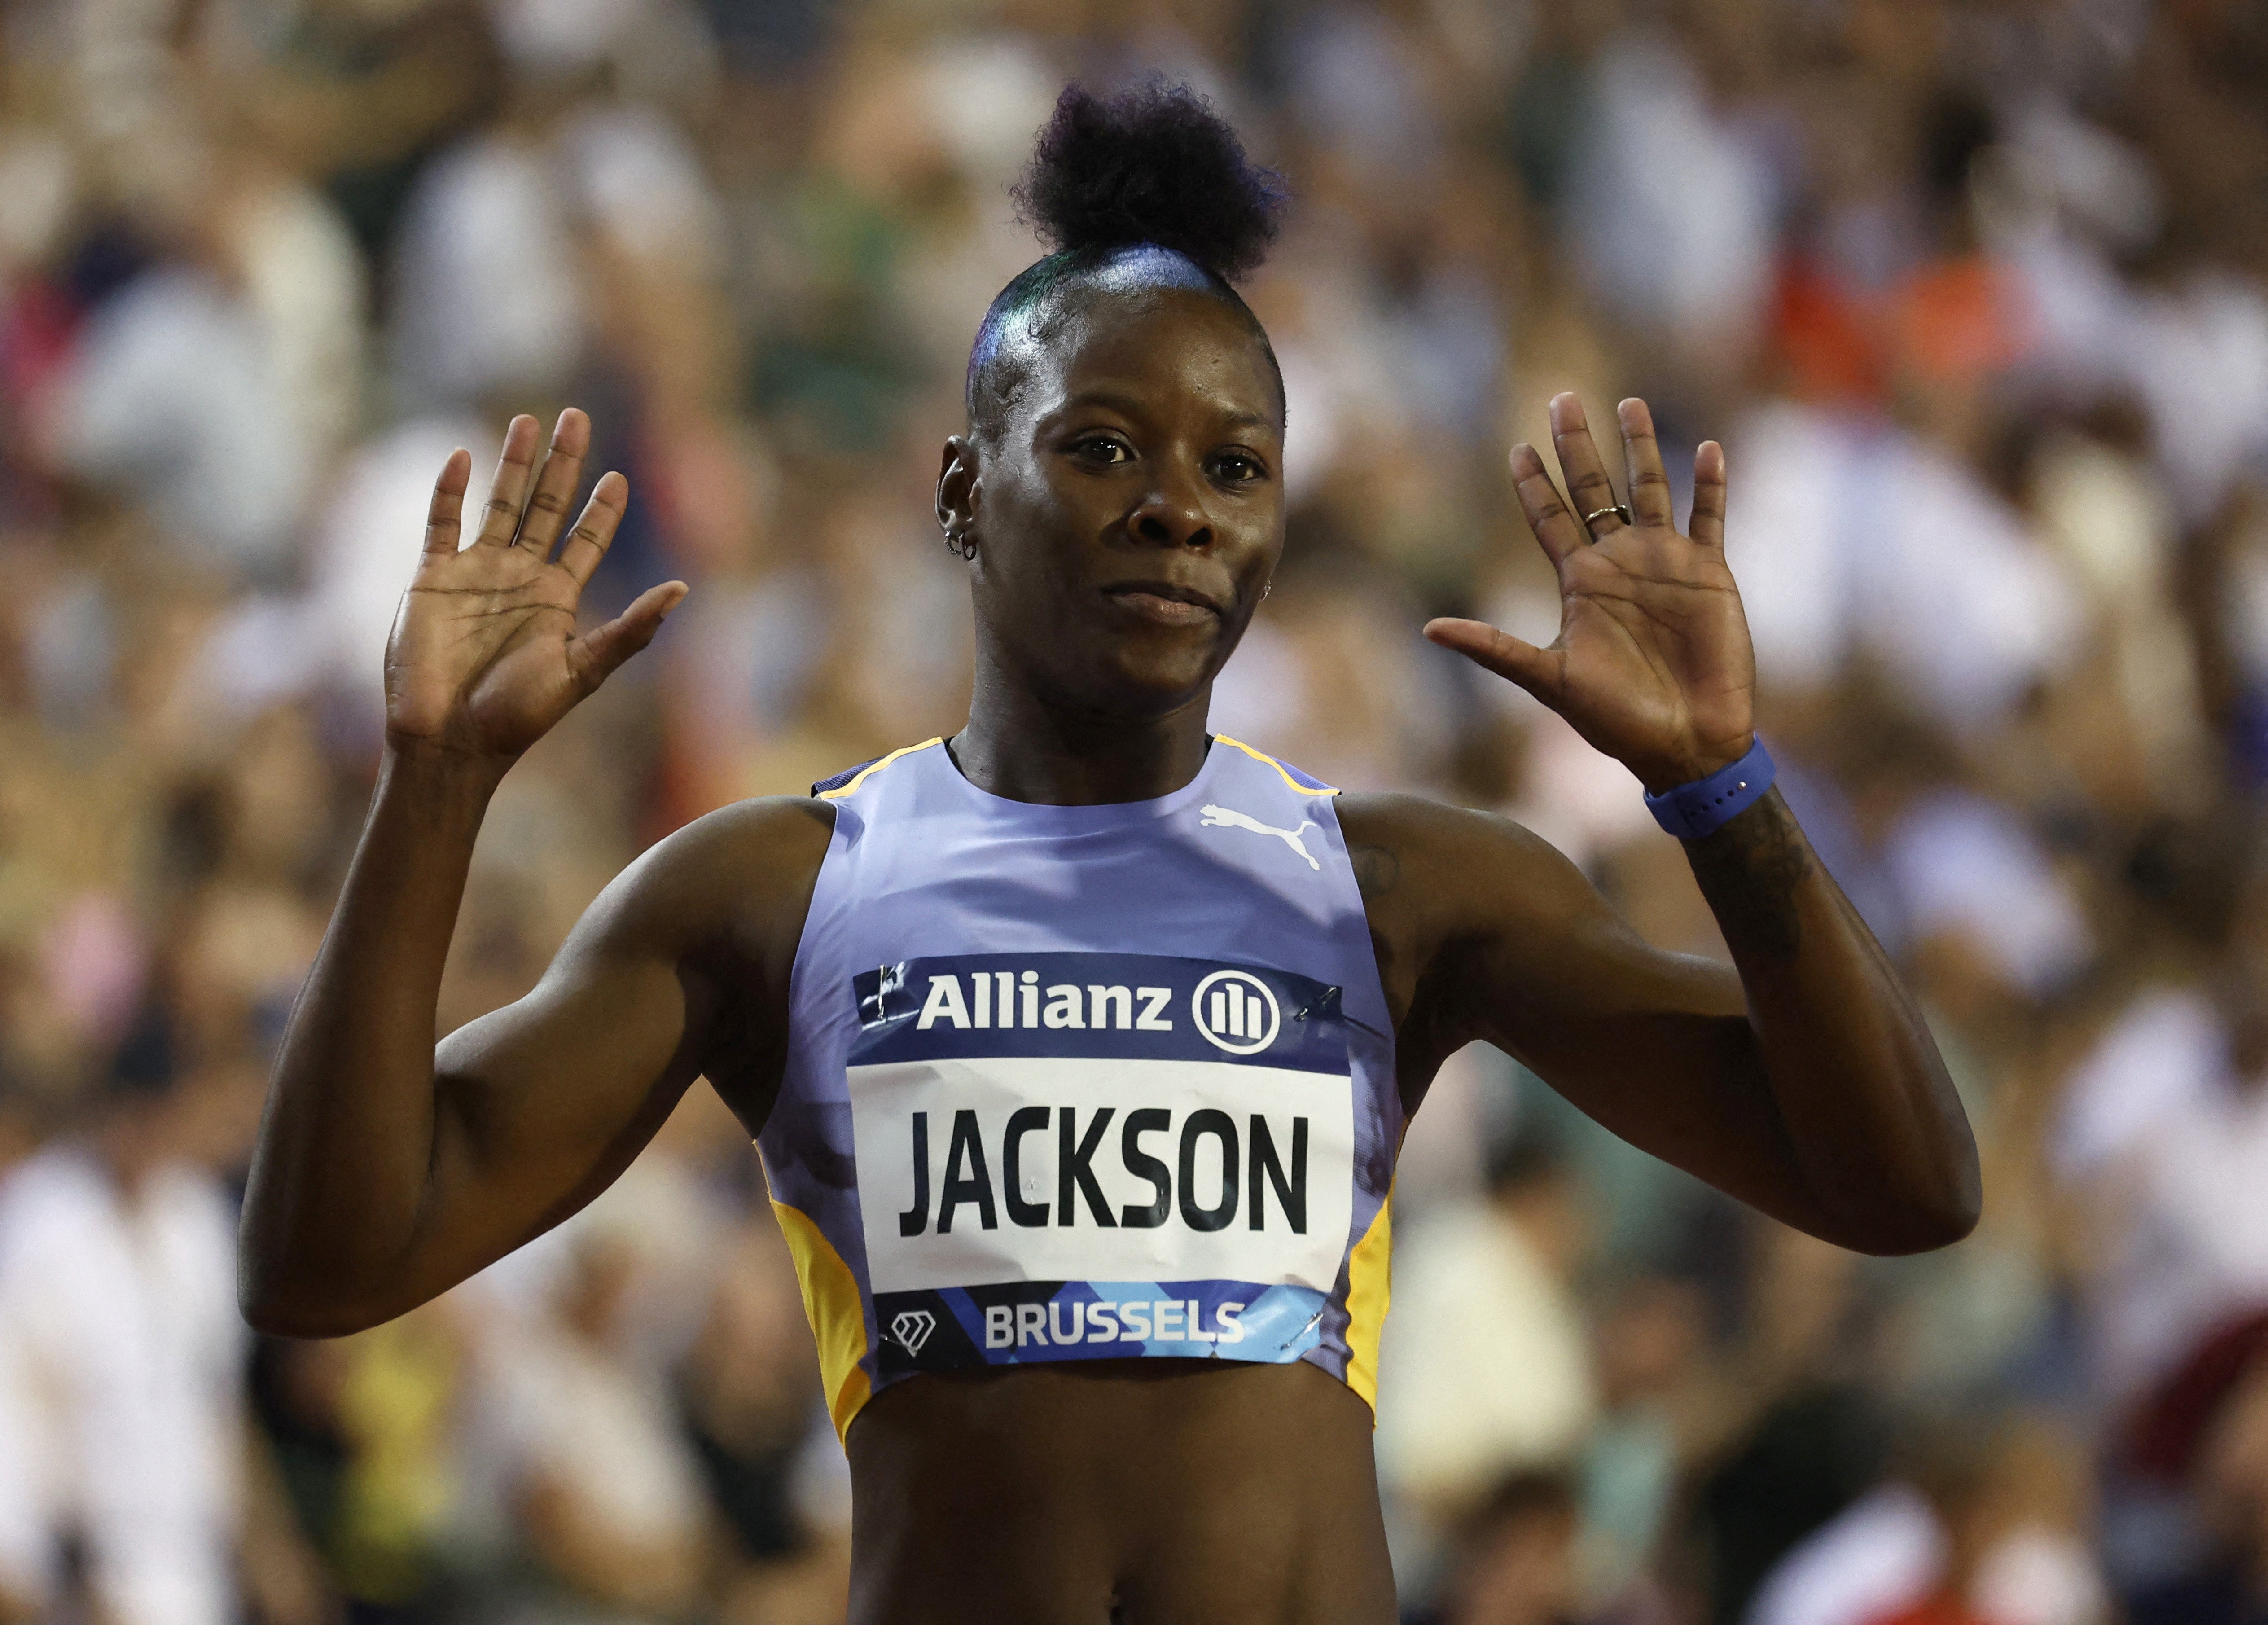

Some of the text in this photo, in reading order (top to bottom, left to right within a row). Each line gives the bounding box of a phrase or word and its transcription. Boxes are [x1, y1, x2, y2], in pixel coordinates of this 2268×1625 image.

[916, 970, 1172, 1032] Allianz
[899, 1106, 1308, 1236] JACKSON
[985, 1300, 1245, 1349] BRUSSELS
